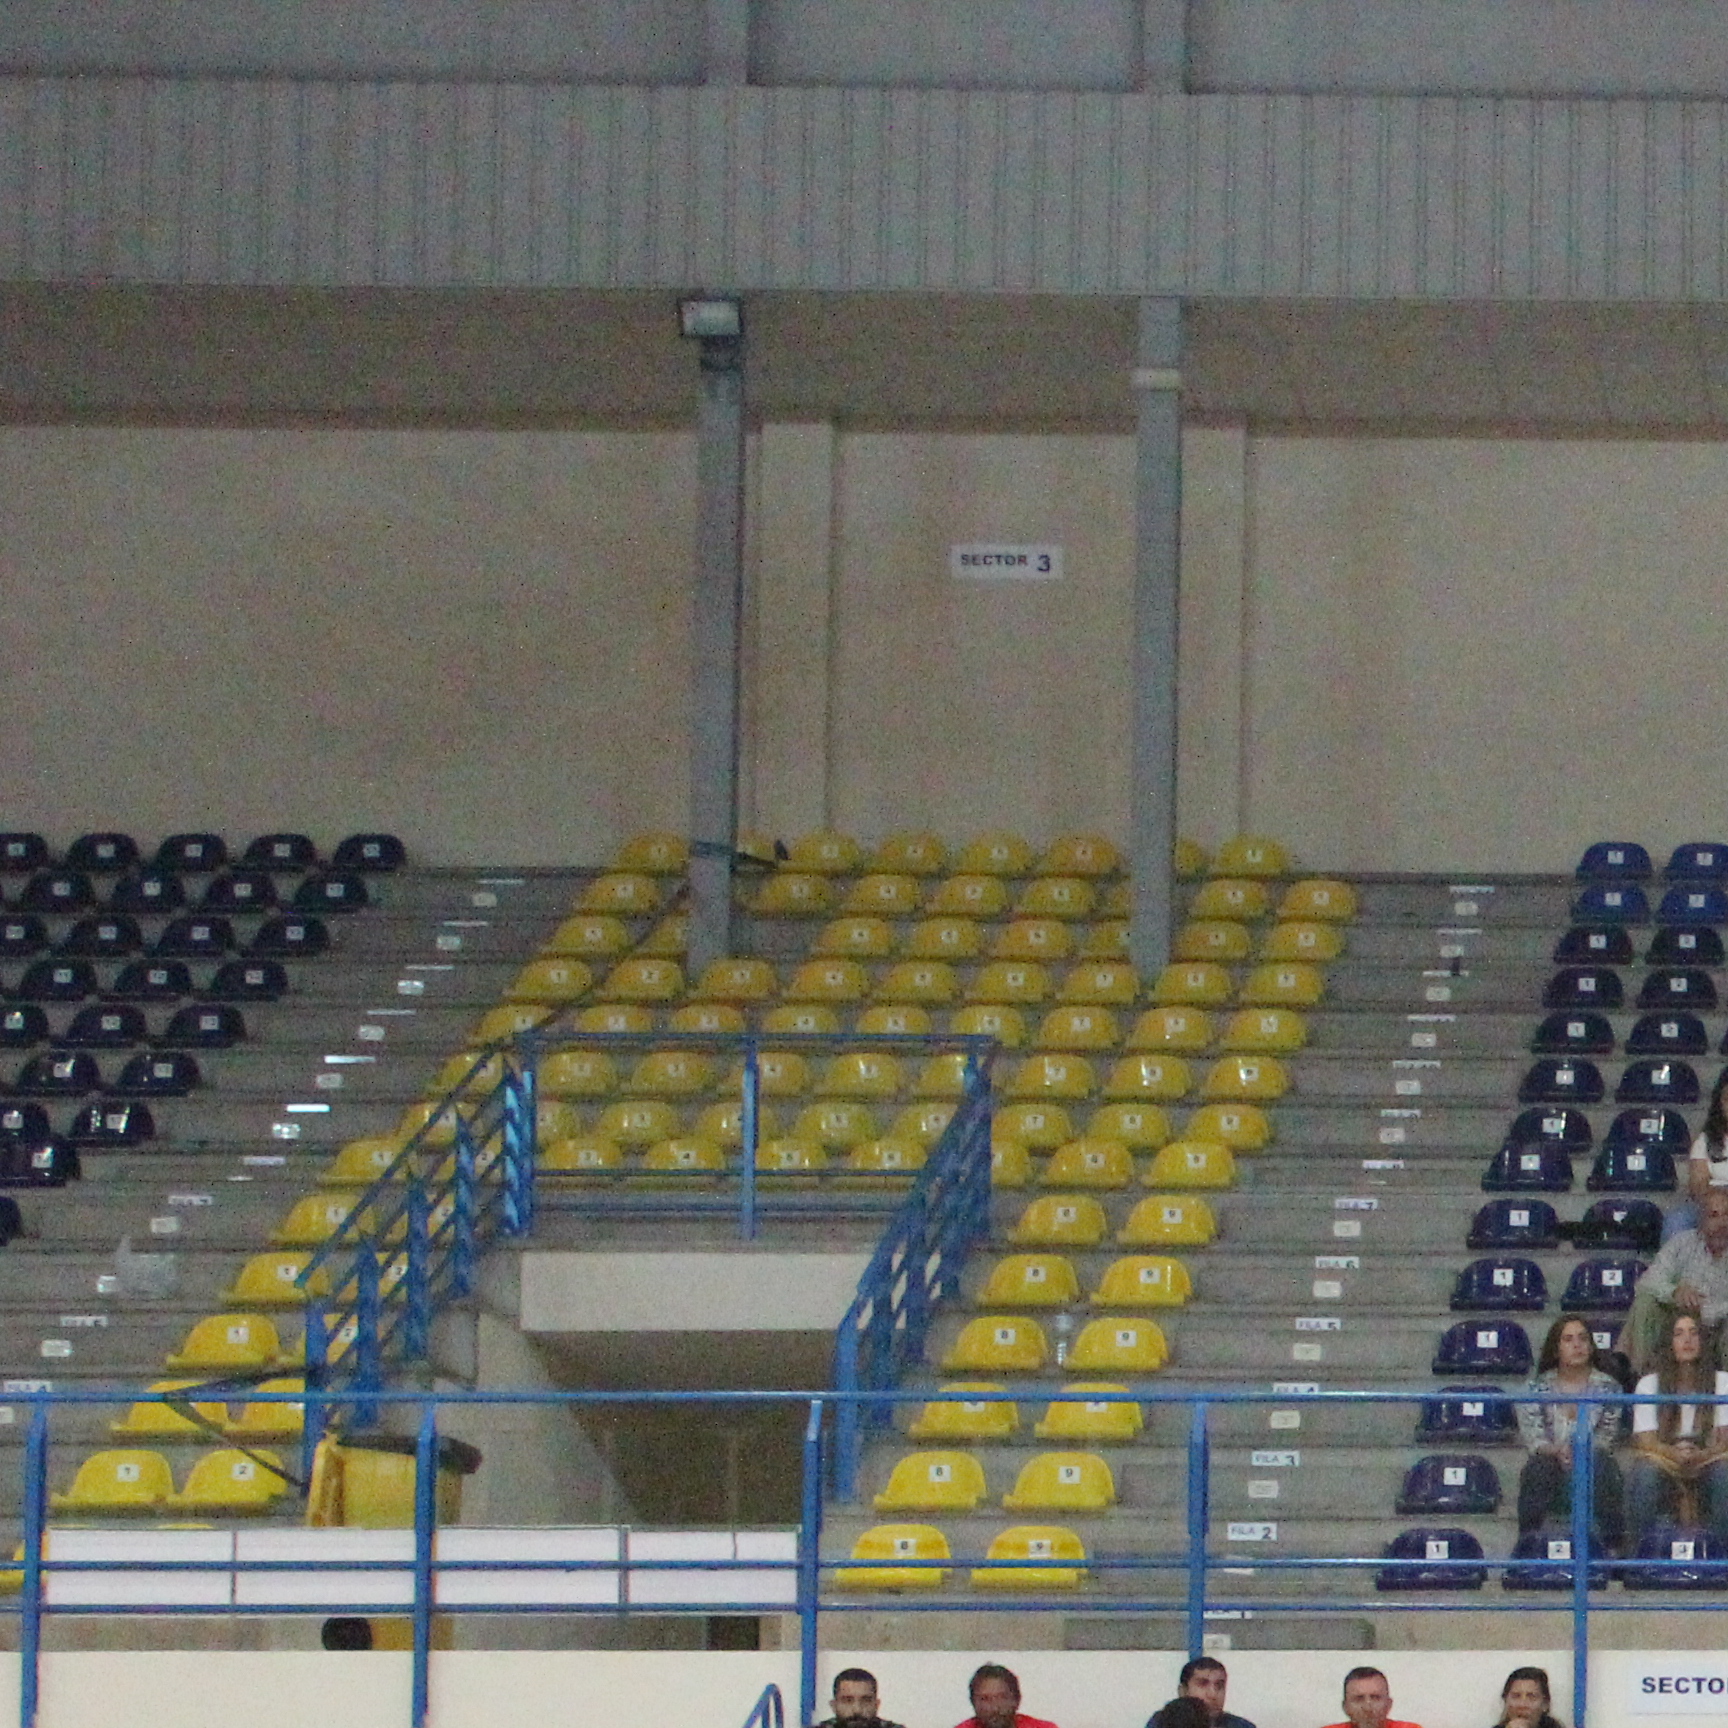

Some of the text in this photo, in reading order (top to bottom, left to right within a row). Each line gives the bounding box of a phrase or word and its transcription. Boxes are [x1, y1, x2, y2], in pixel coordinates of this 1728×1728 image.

[960, 553, 1051, 573] SECTOR 3
[1254, 1454, 1281, 1466] FILA
[1230, 1525, 1272, 1540] FILA 2
